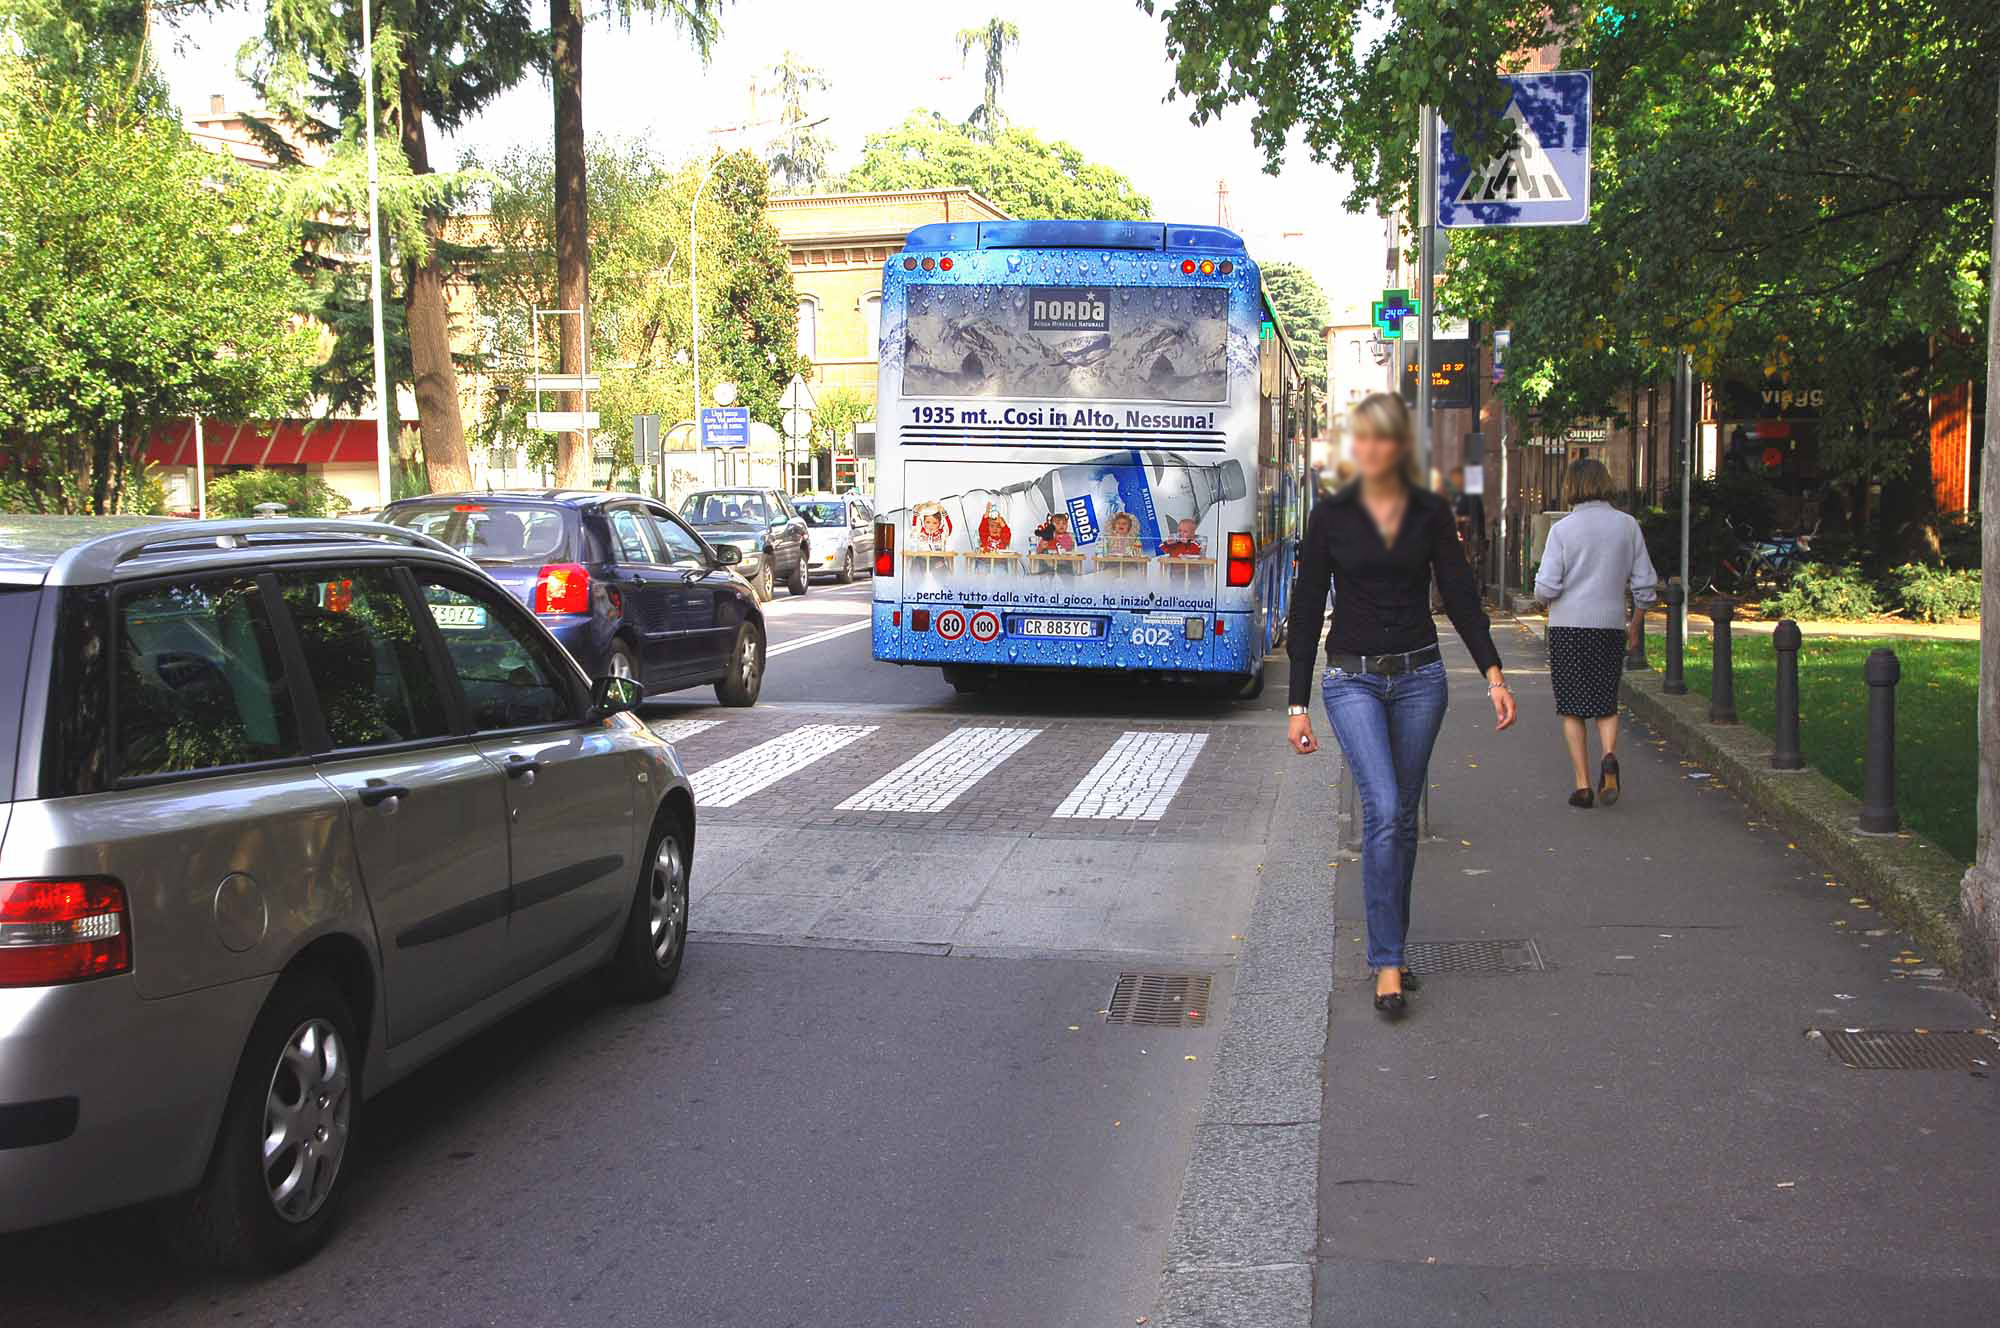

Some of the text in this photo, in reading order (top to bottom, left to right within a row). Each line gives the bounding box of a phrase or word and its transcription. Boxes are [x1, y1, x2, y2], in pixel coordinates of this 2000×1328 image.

[912, 406, 955, 424] 1935
[1049, 408, 1068, 426] in
[1073, 409, 1119, 430] Alto,
[1126, 410, 1214, 429] Nessuna!
[958, 591, 988, 602] tutto
[992, 592, 1020, 602] dalla
[1023, 593, 1046, 604] vita
[1049, 593, 1060, 604] al
[1063, 594, 1097, 608] gioco,
[1102, 594, 1116, 606] ha
[1120, 595, 1150, 607] inizio
[942, 618, 960, 632] 80
[975, 621, 993, 633] 100
[1026, 620, 1042, 634] CR
[1046, 620, 1089, 636] 883YC
[1132, 627, 1170, 646] 602
